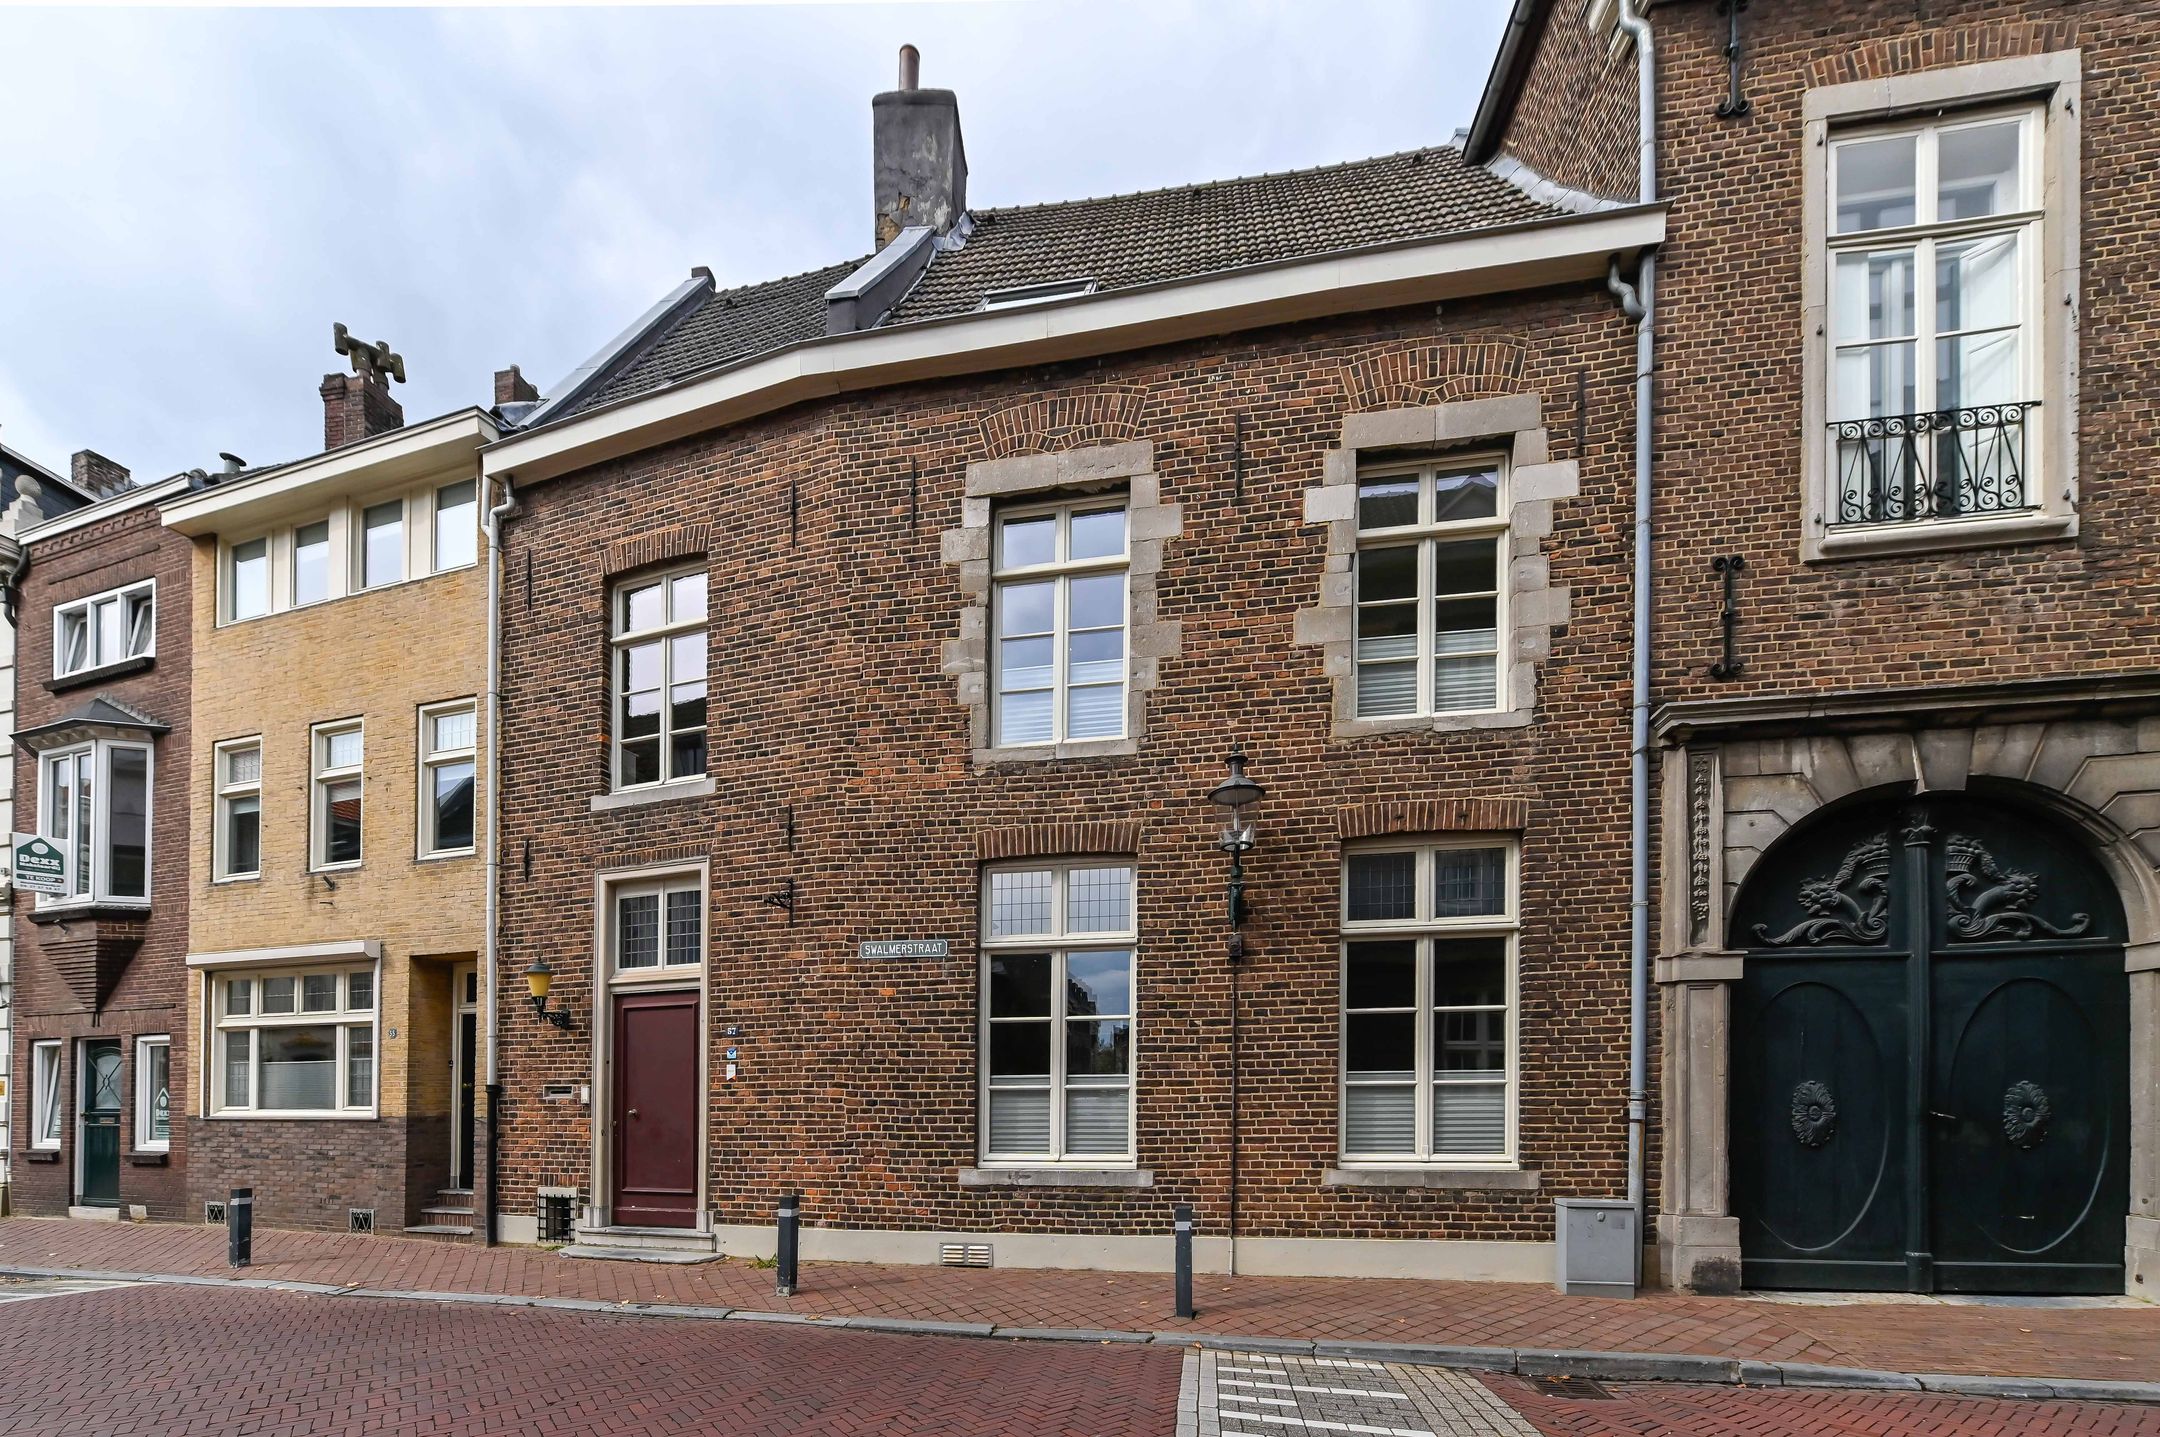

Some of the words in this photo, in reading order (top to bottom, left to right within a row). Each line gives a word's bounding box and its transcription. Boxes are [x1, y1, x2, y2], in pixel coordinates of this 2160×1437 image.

[19, 854, 60, 867] Dexx
[865, 943, 942, 954] SWALMERSTRAAT
[727, 1027, 736, 1035] 57
